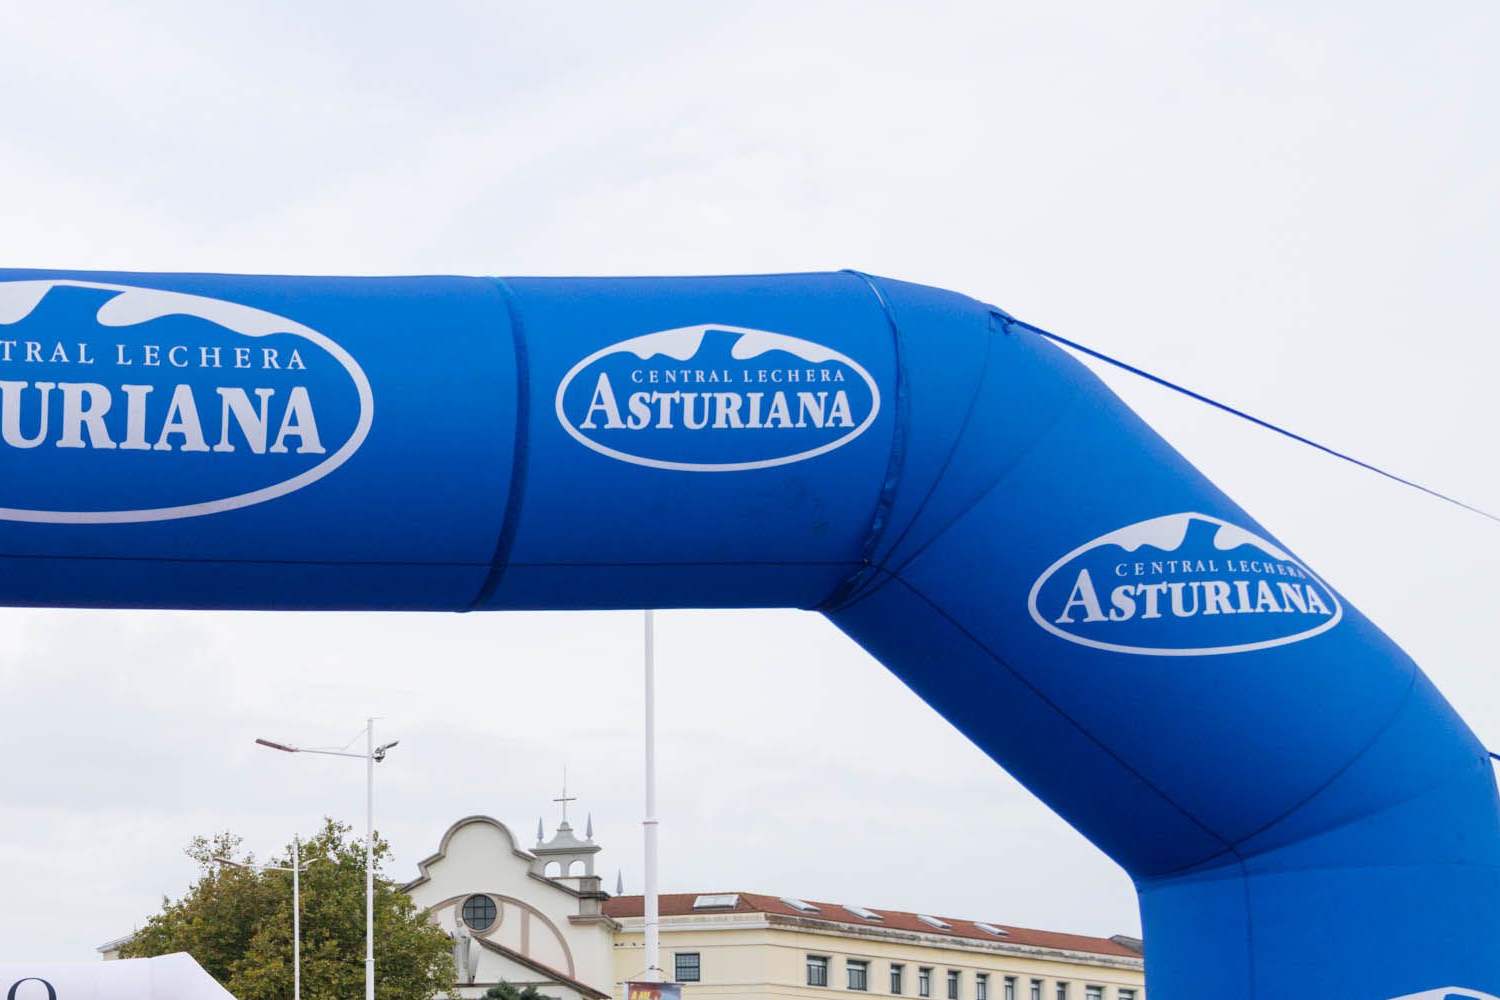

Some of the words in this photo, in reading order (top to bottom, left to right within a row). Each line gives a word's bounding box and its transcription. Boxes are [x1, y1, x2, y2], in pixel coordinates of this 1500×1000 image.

[116, 344, 307, 370] LECHERA
[631, 369, 734, 383] CENTRAL
[743, 369, 845, 382] LECHERA
[580, 373, 854, 430] ASTURIANA
[1115, 559, 1219, 577] CENTRAL
[1055, 569, 1332, 624] ASTURIANA
